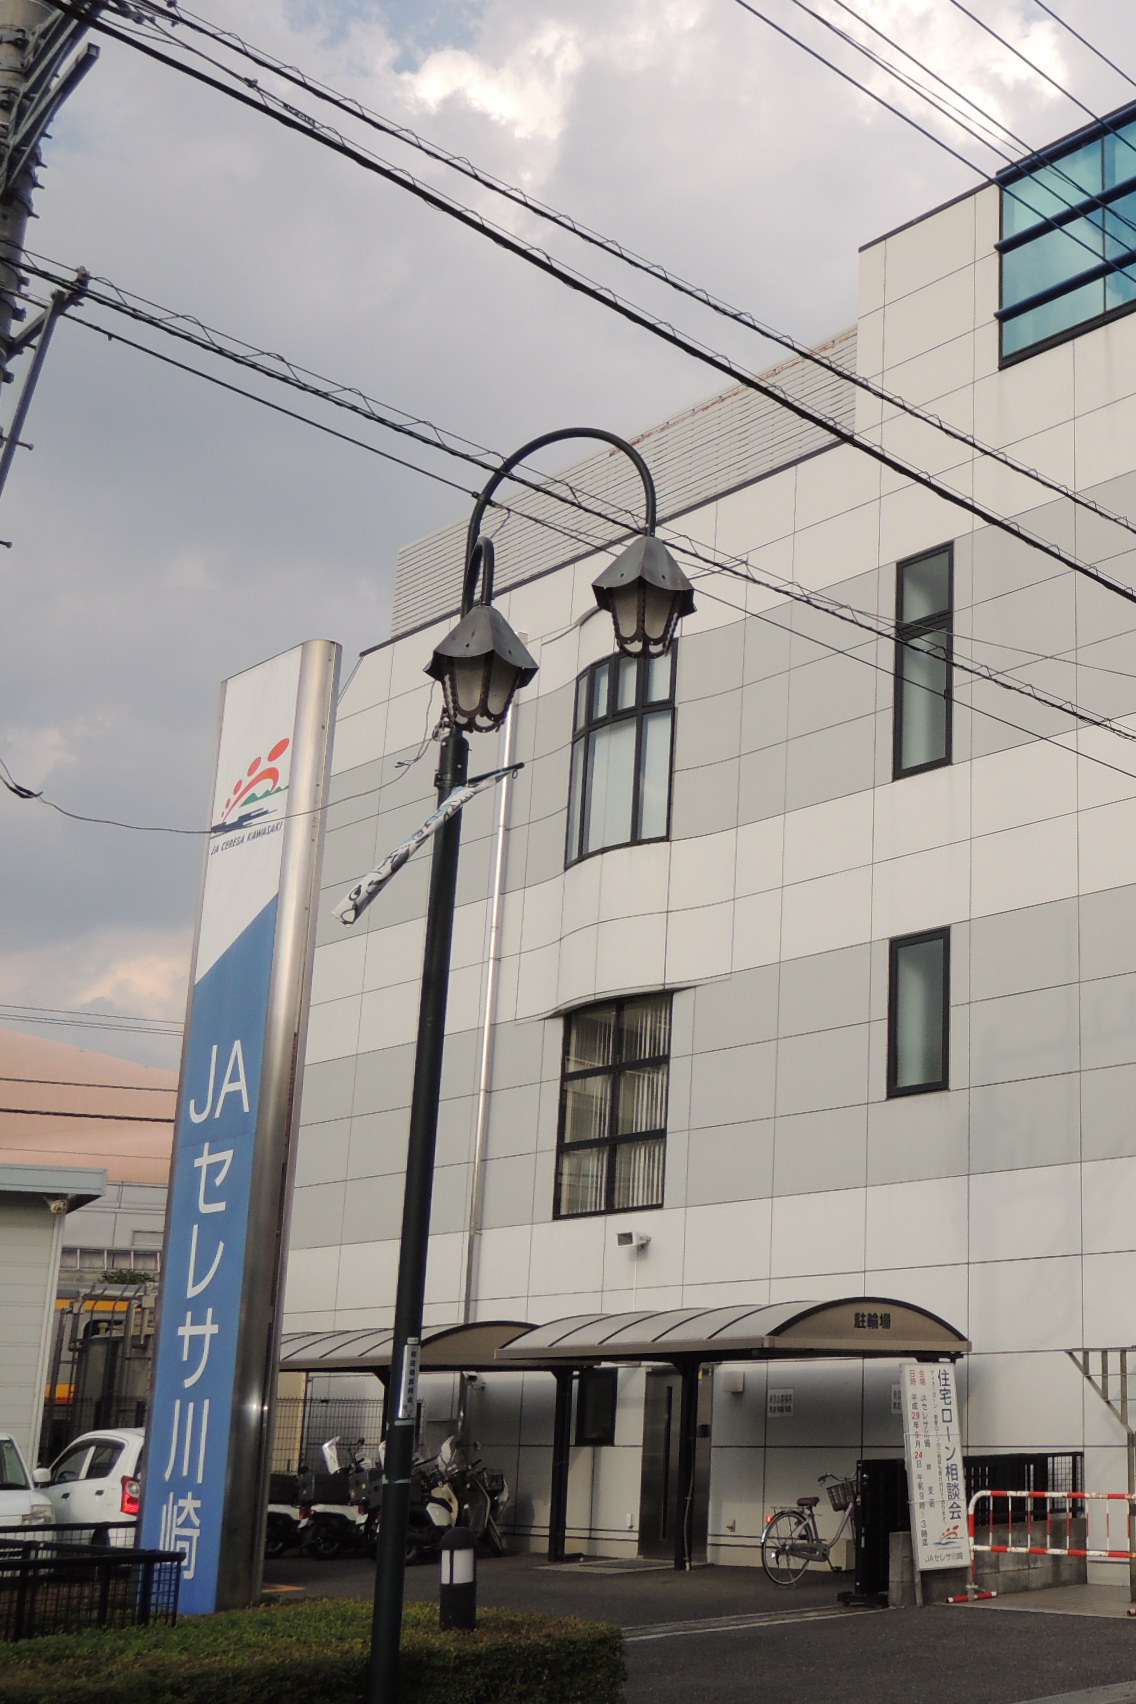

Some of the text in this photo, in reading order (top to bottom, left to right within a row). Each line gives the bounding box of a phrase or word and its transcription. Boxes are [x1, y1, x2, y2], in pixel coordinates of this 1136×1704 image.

[210, 821, 283, 855] JA CERESA KAWASAKI
[853, 1311, 891, 1329] 駐輪場
[938, 1368, 962, 1520] 住宅ローン相談会
